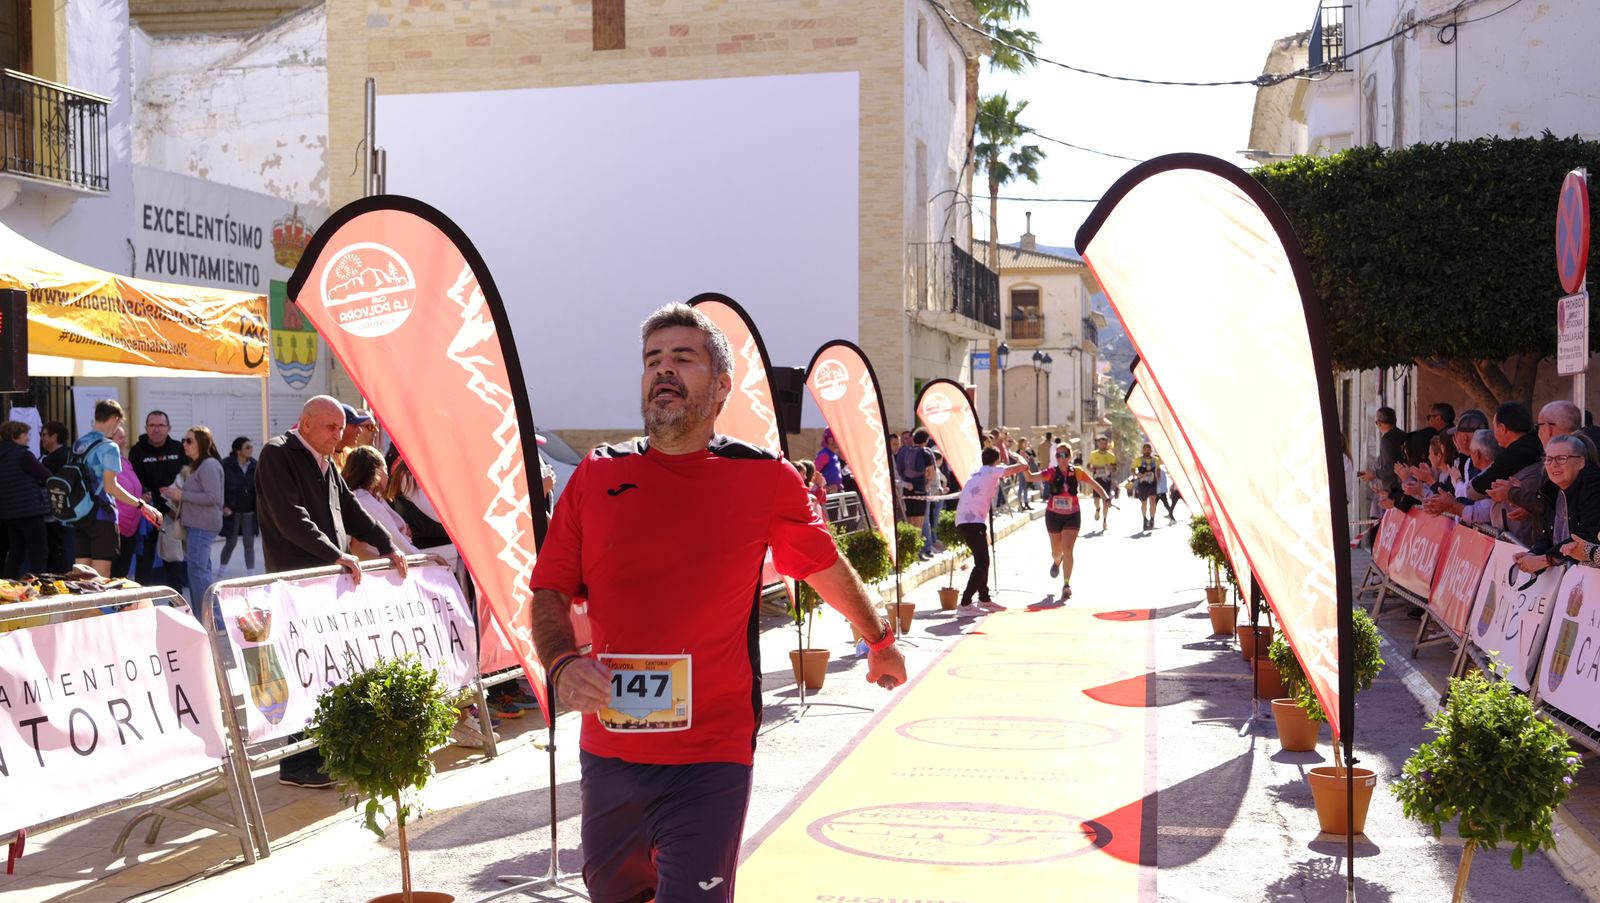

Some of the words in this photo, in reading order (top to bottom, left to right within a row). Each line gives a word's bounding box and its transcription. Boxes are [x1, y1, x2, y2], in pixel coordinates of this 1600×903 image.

[143, 204, 262, 250] EXCELENTÍSIMO
[145, 247, 260, 287] AYUNTAMIENTO
[289, 601, 426, 639] AYUNTAMIENTO
[432, 596, 455, 615] DE
[149, 650, 181, 678] DE
[295, 620, 465, 688] CANTORIA
[610, 674, 669, 697] 147
